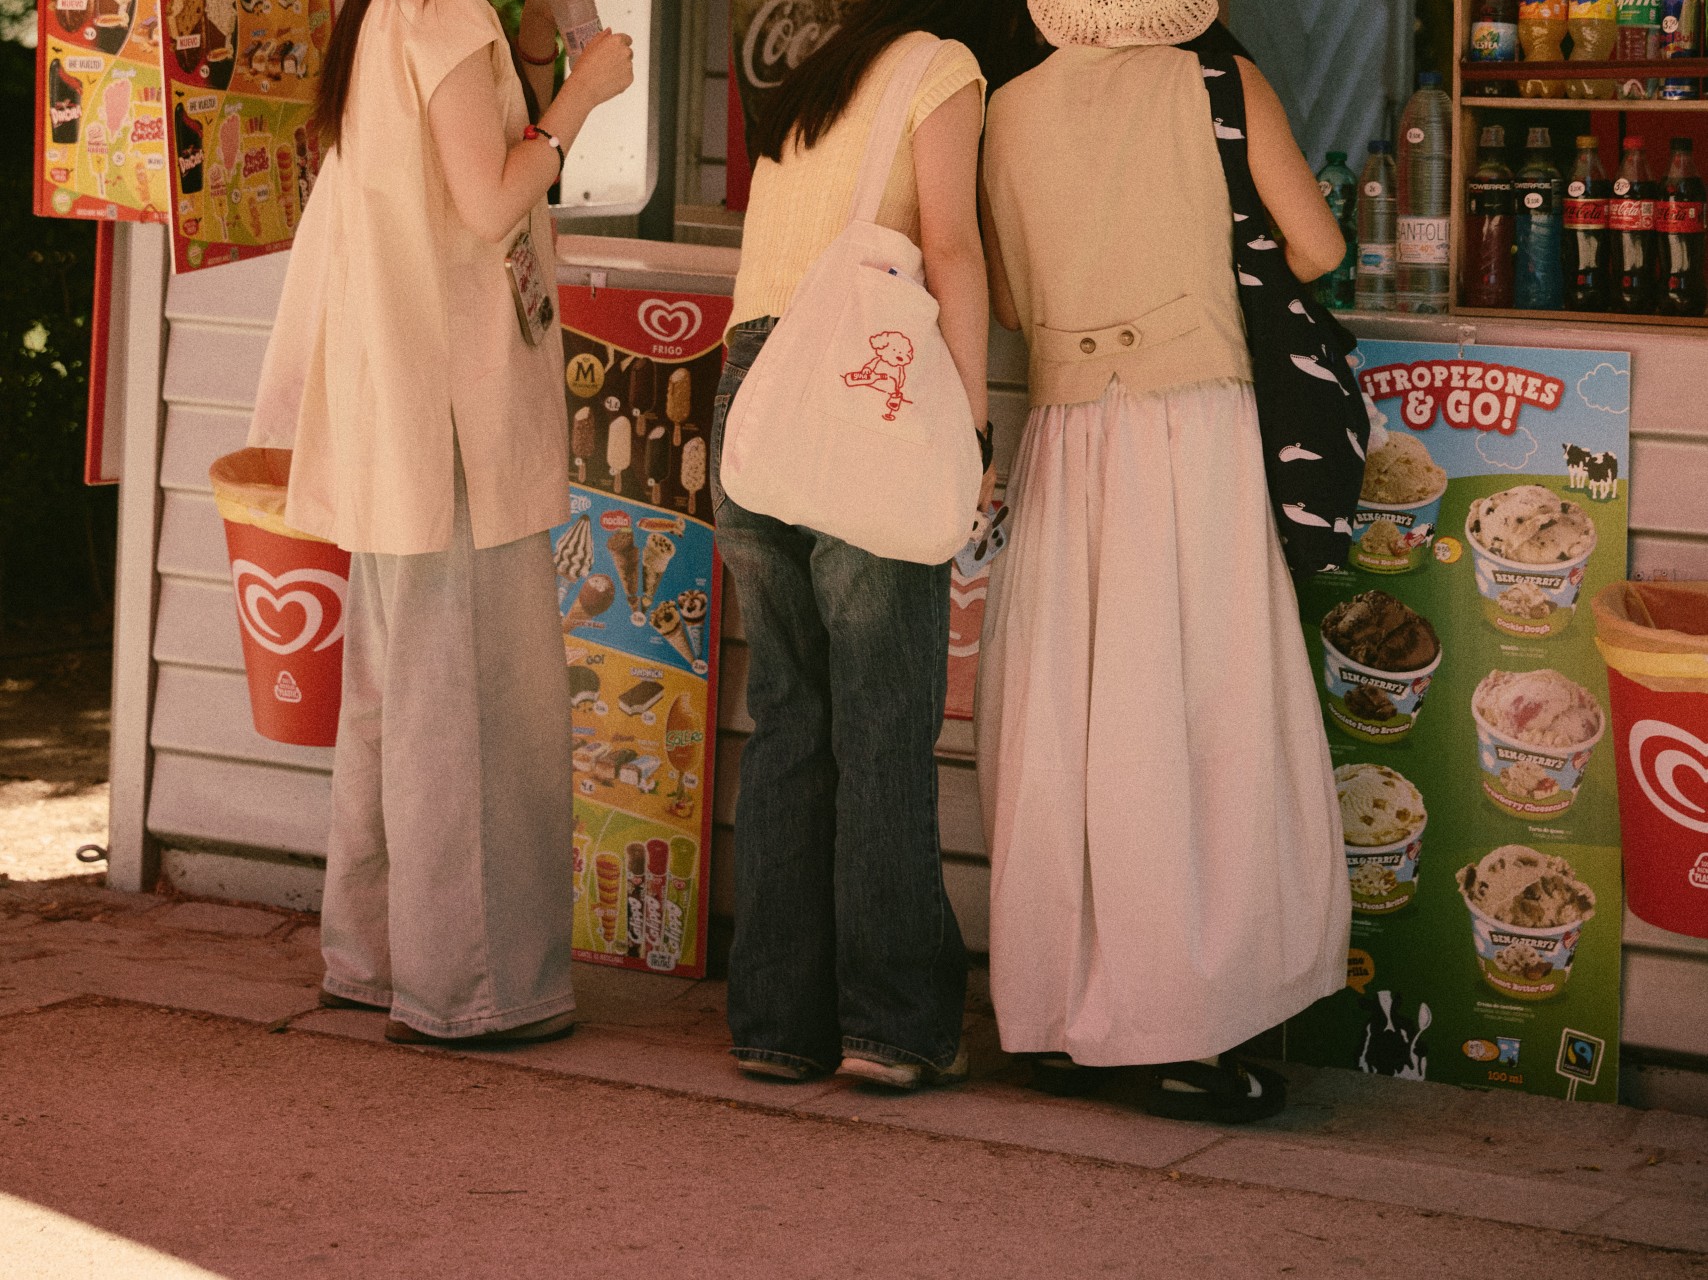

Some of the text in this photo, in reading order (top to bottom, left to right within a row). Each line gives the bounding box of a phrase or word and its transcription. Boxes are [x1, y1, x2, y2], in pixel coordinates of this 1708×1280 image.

[652, 344, 683, 356] FRIGO
[574, 361, 596, 383] M
[1363, 365, 1559, 405] ¡TROPEZONES
[1405, 389, 1517, 430] & GO!
[1497, 617, 1551, 635] Cookie Dough
[1357, 722, 1381, 735] Fudge
[1525, 800, 1570, 813] Cheesecake
[1347, 855, 1360, 866] EN
[1487, 972, 1555, 993] Peanut Butter Cup
[1487, 1071, 1524, 1084] 100 ml
